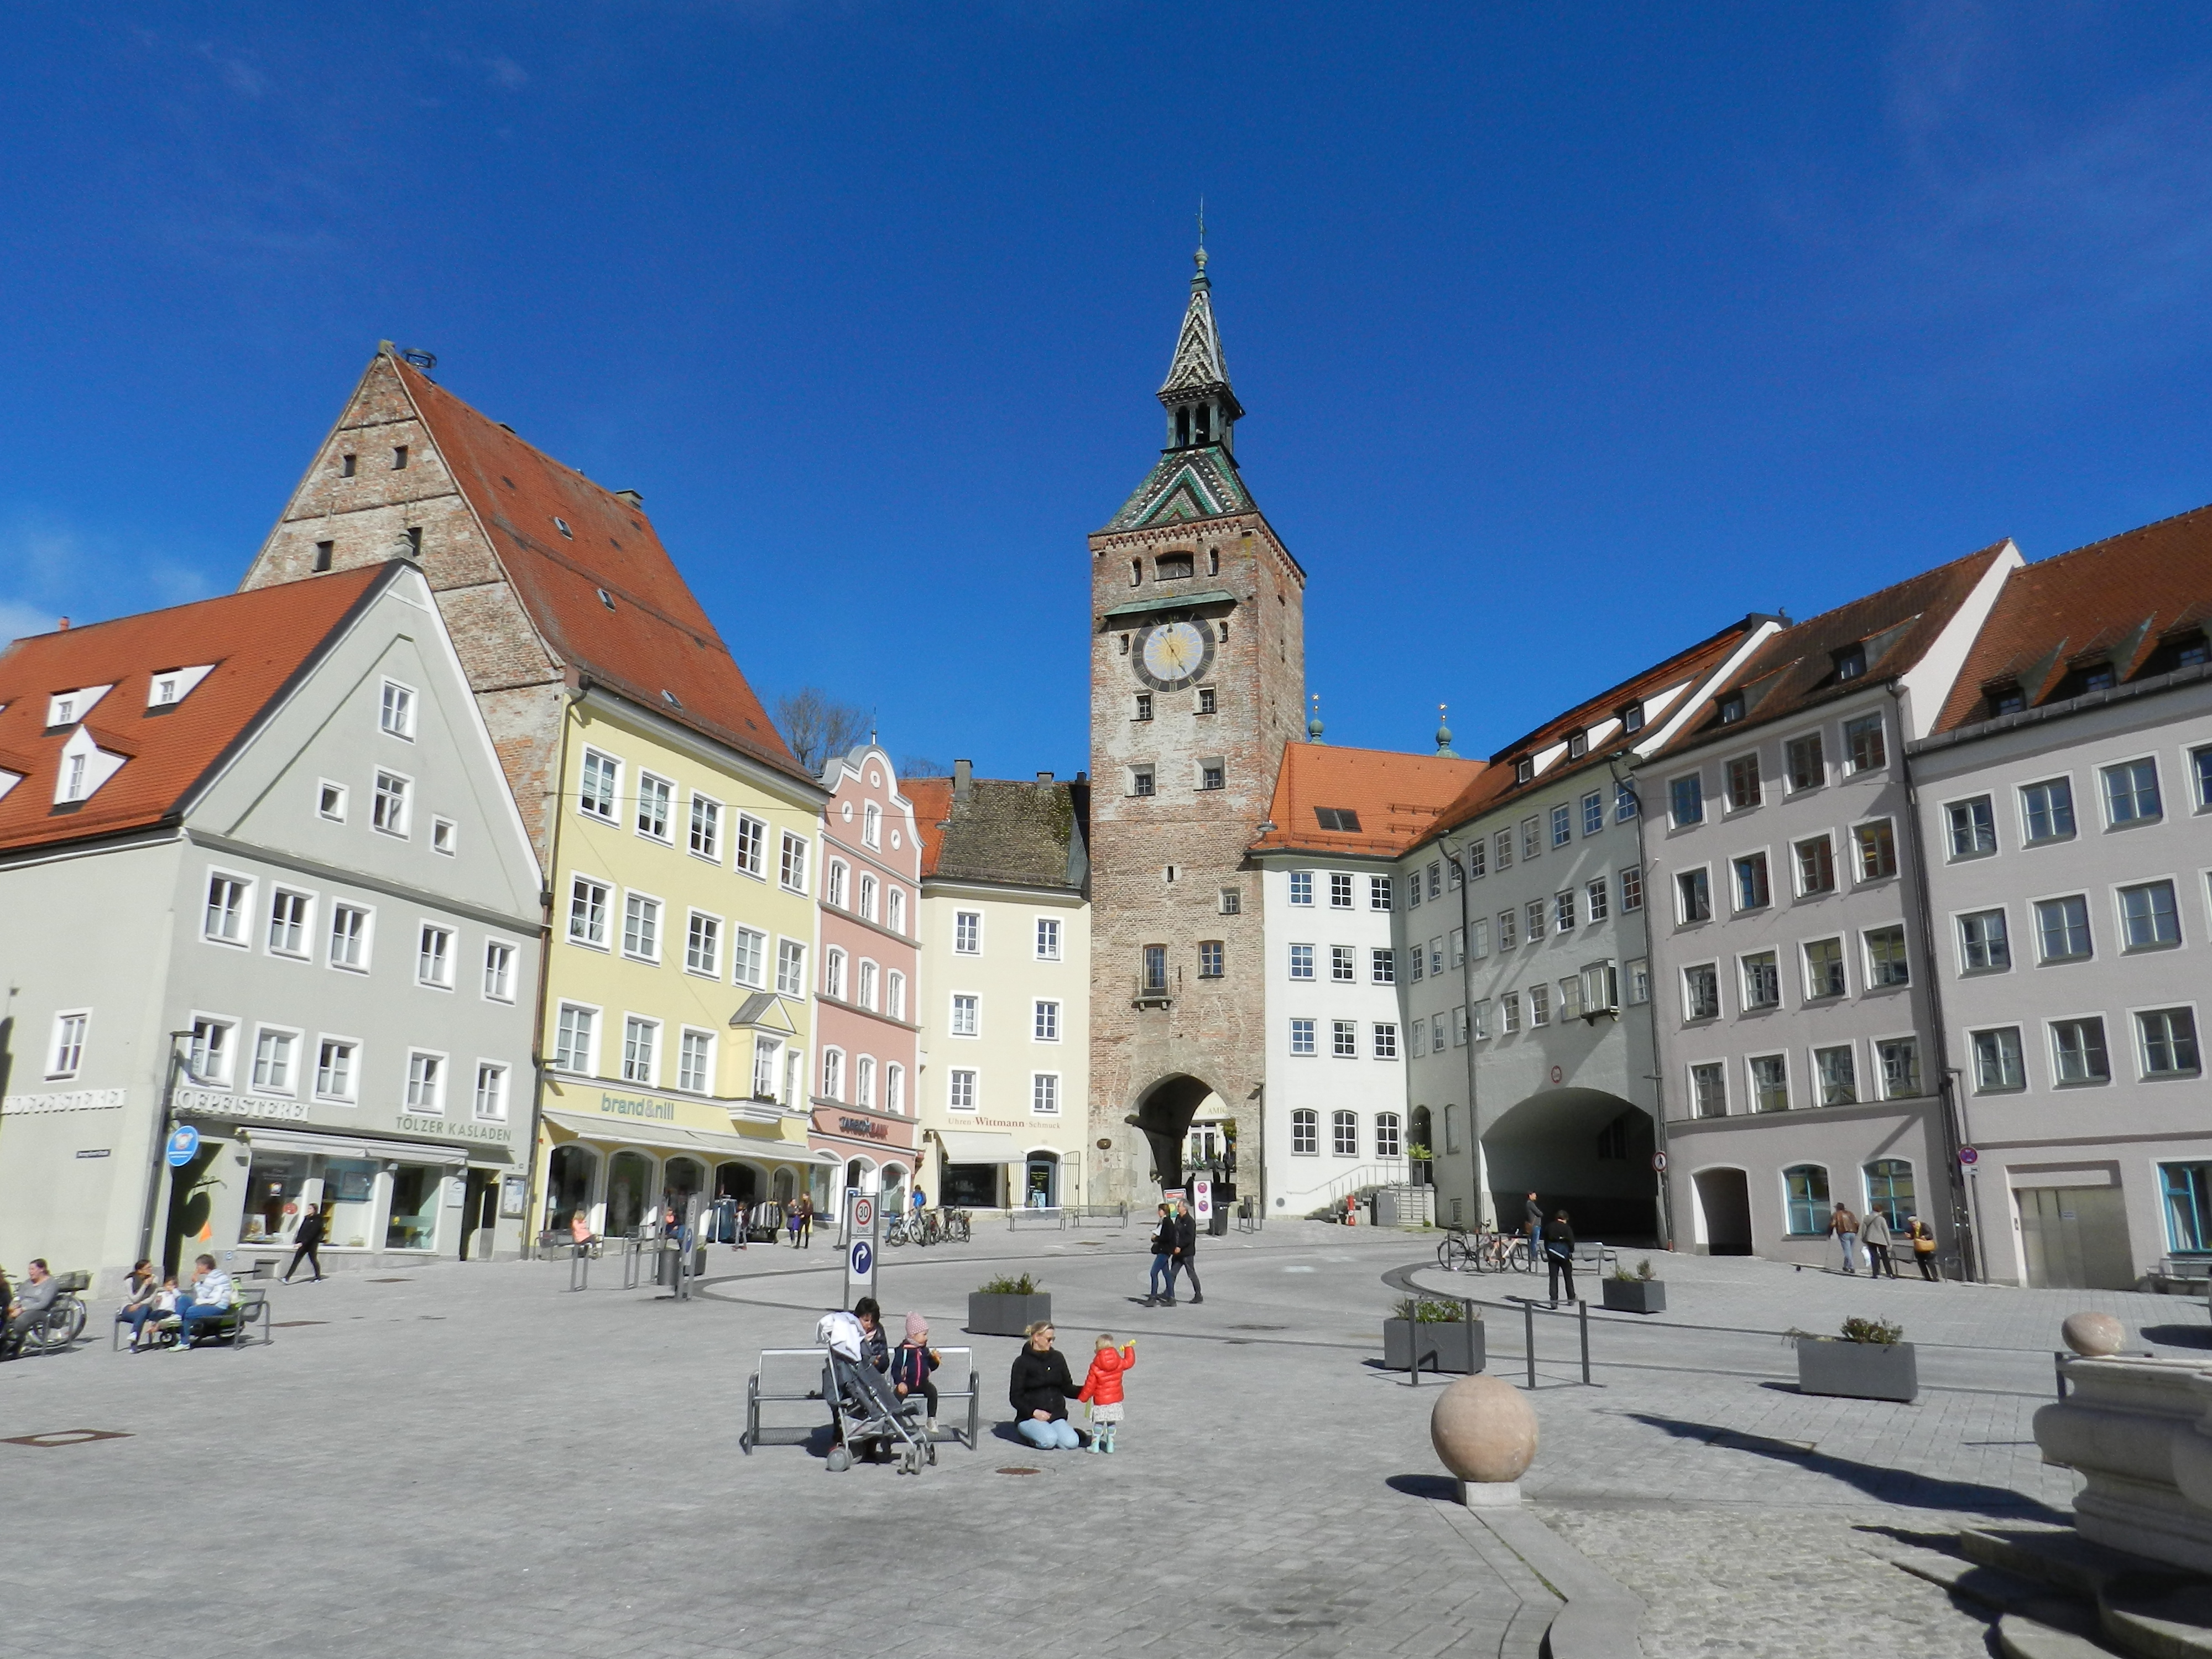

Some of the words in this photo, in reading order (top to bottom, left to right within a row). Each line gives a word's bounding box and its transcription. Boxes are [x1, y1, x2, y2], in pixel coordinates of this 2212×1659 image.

[601, 1092, 674, 1120] brand&nill
[395, 1114, 444, 1134] TÖLZER
[448, 1122, 512, 1141] KASLADEN
[948, 1117, 972, 1125] Uhren
[975, 1116, 1025, 1128] Wittmann
[859, 1206, 868, 1218] 30
